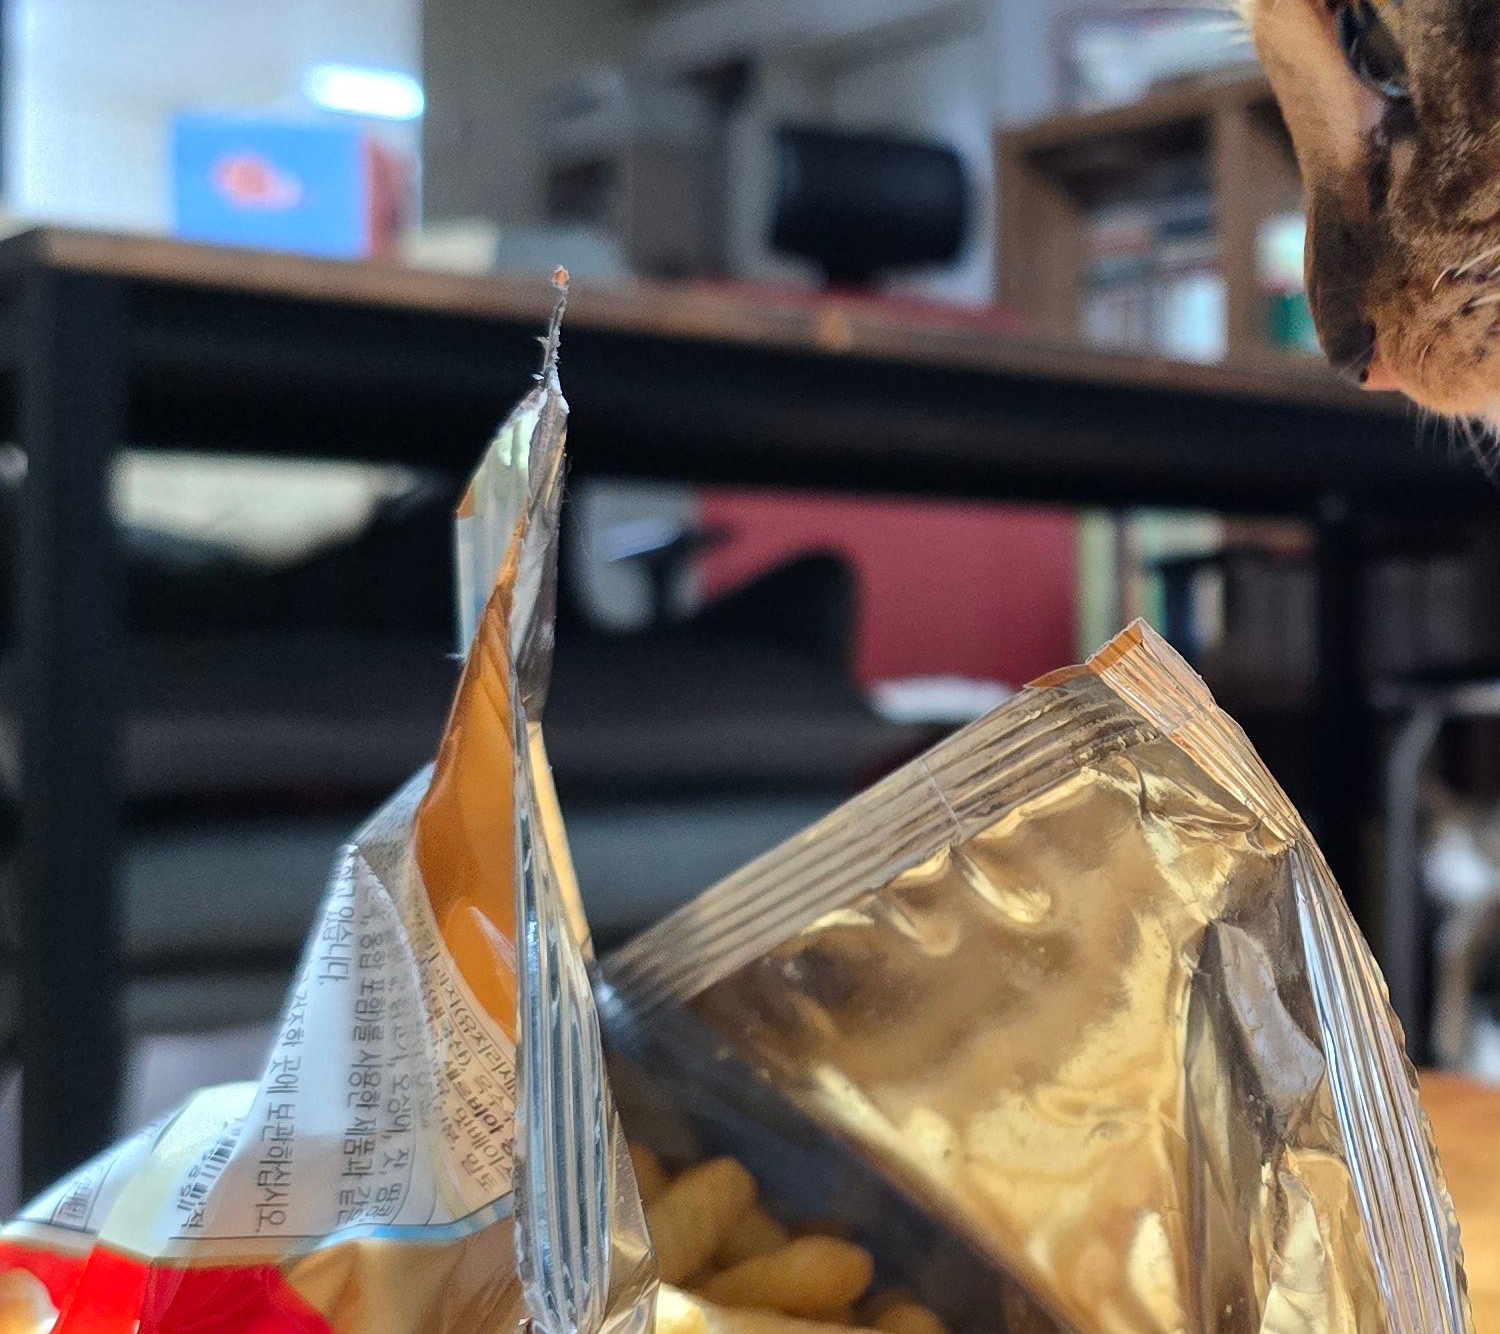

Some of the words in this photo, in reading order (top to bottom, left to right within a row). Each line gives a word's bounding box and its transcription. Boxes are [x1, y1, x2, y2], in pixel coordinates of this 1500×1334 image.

[318, 905, 356, 986] 있습니다.
[353, 977, 386, 1043] 포함)를
[266, 1055, 302, 1095] 곳에
[348, 1049, 383, 1112] 사용한
[382, 1073, 413, 1140] 오징어,
[256, 1102, 297, 1233] 보관하십시오.
[342, 1117, 377, 1178] 제품과
